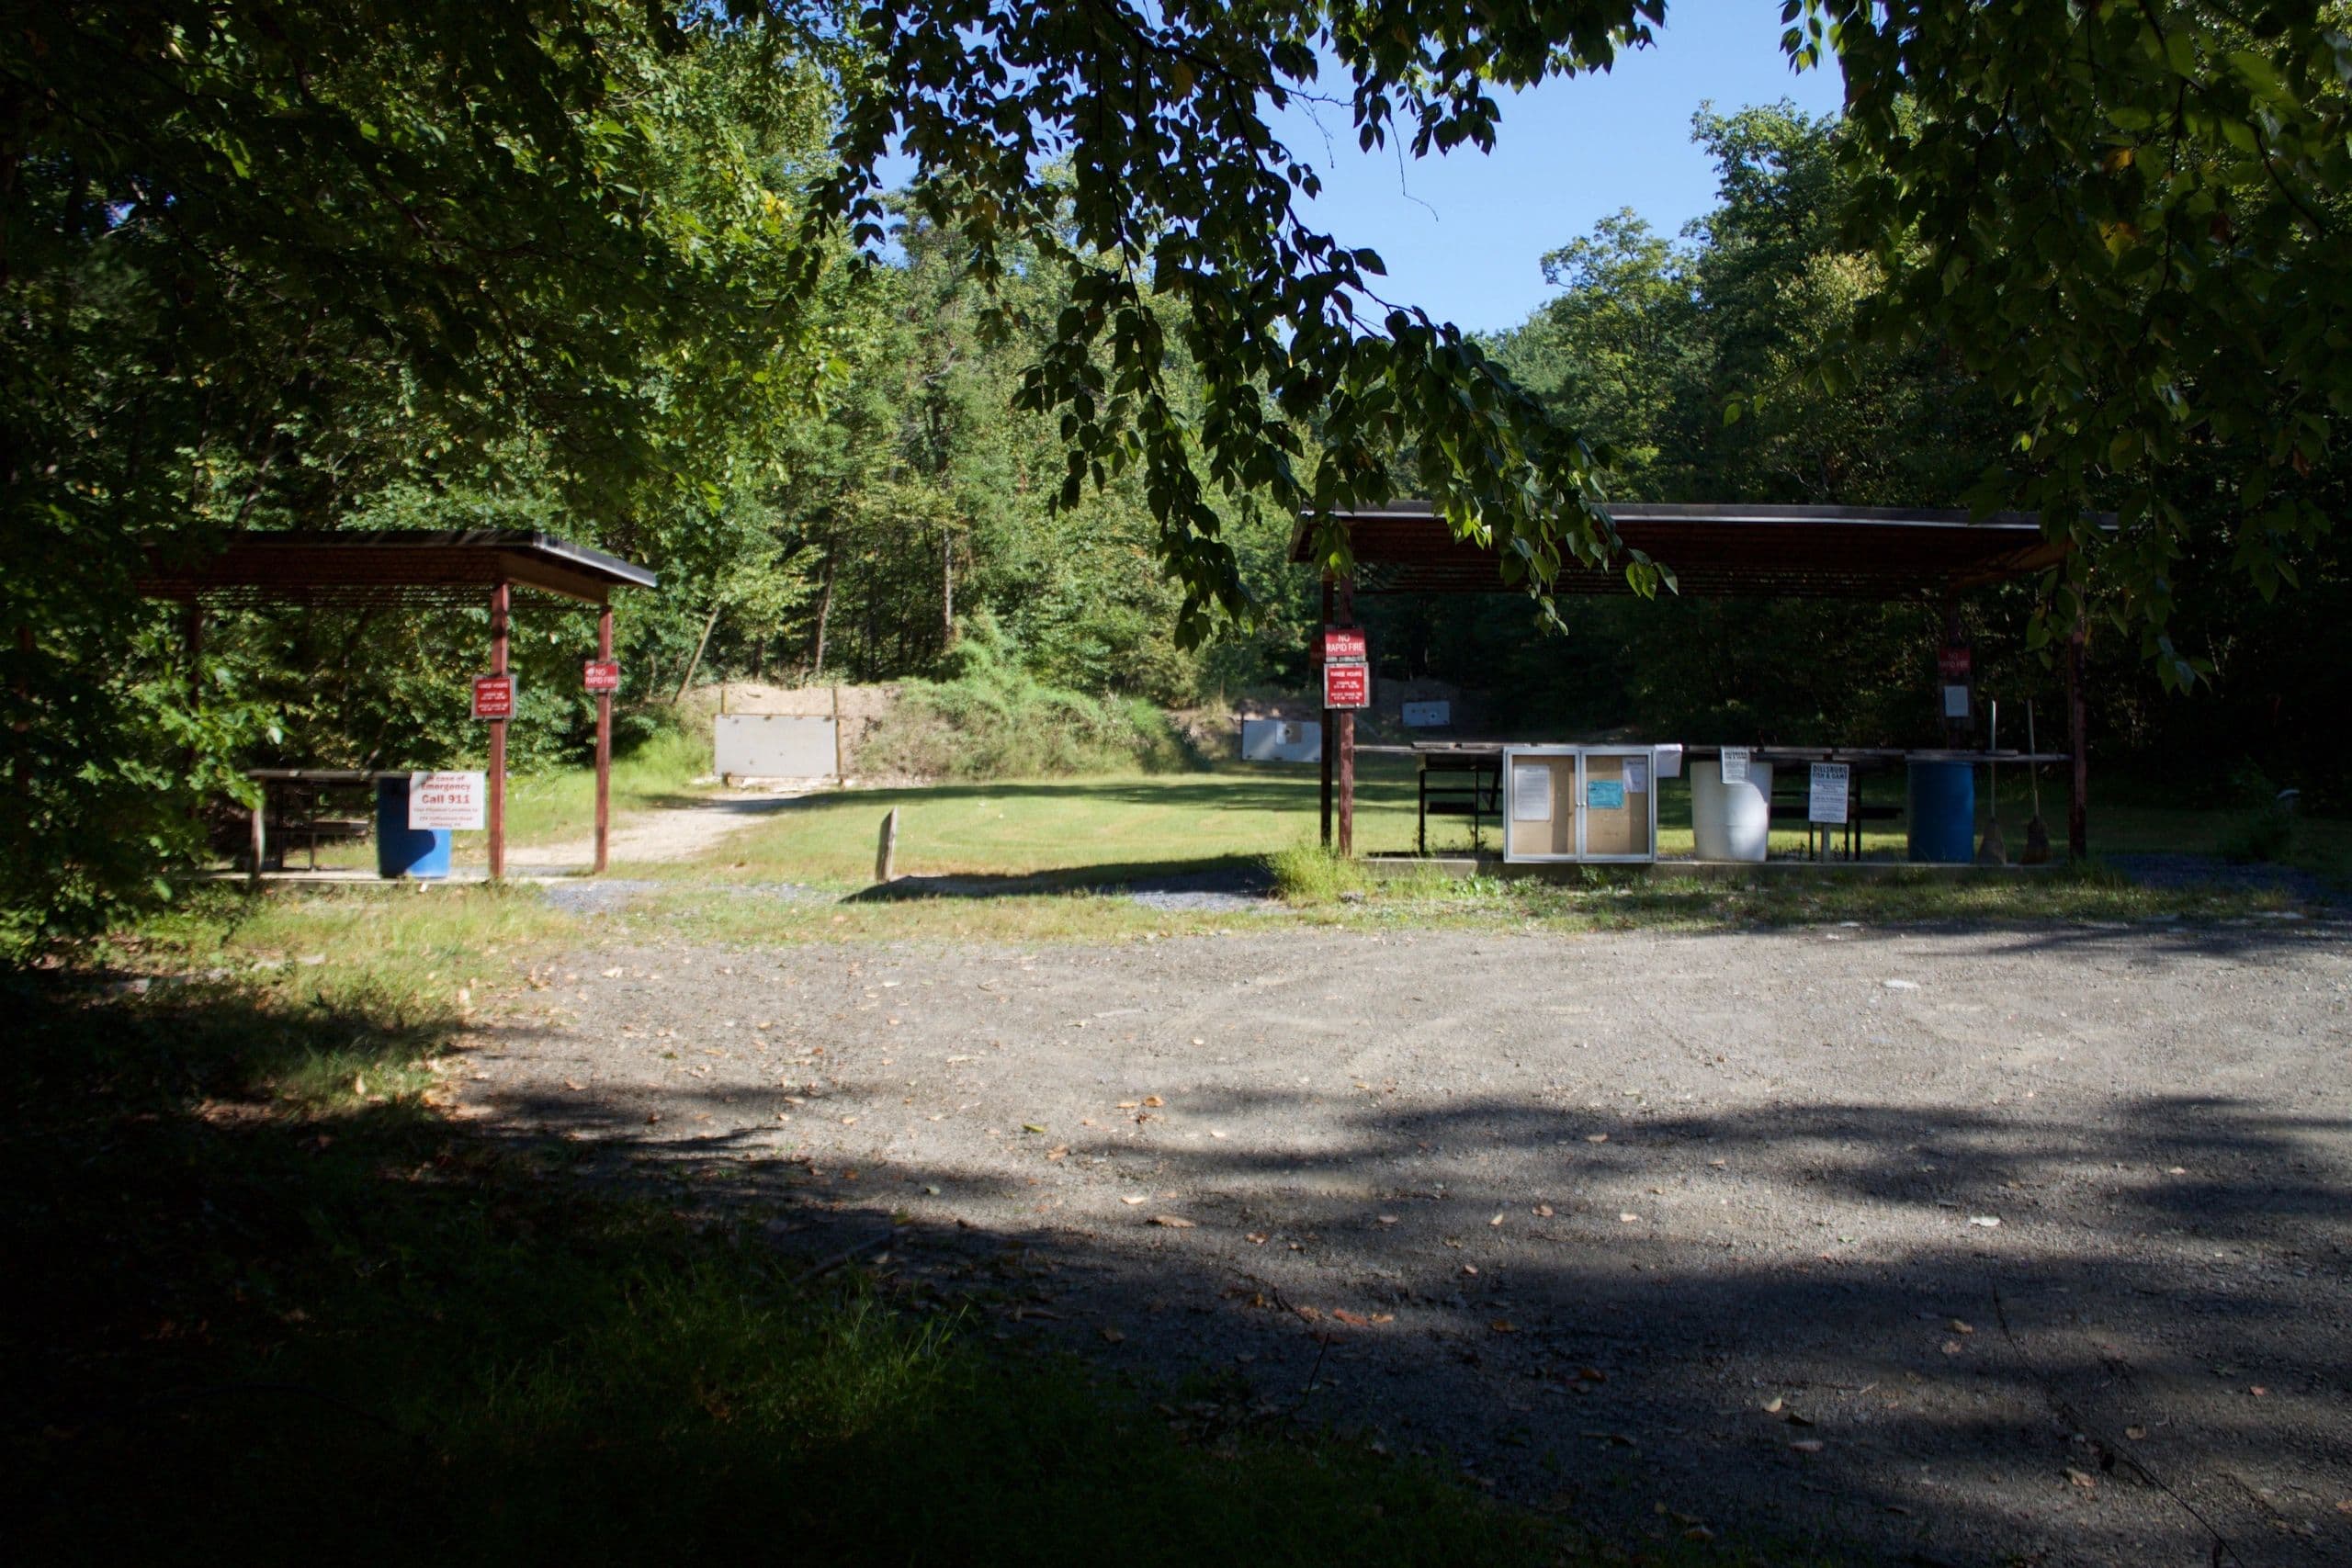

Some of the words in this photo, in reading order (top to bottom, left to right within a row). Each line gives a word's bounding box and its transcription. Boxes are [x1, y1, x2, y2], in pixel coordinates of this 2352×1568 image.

[1338, 634, 1350, 642] NO
[1327, 643, 1347, 652] RAPID
[1348, 642, 1364, 651] FIRE
[595, 668, 606, 676] NO
[585, 676, 603, 684] RAPID
[421, 783, 470, 792] Emergency
[422, 795, 445, 804] Call
[447, 795, 470, 804] 911
